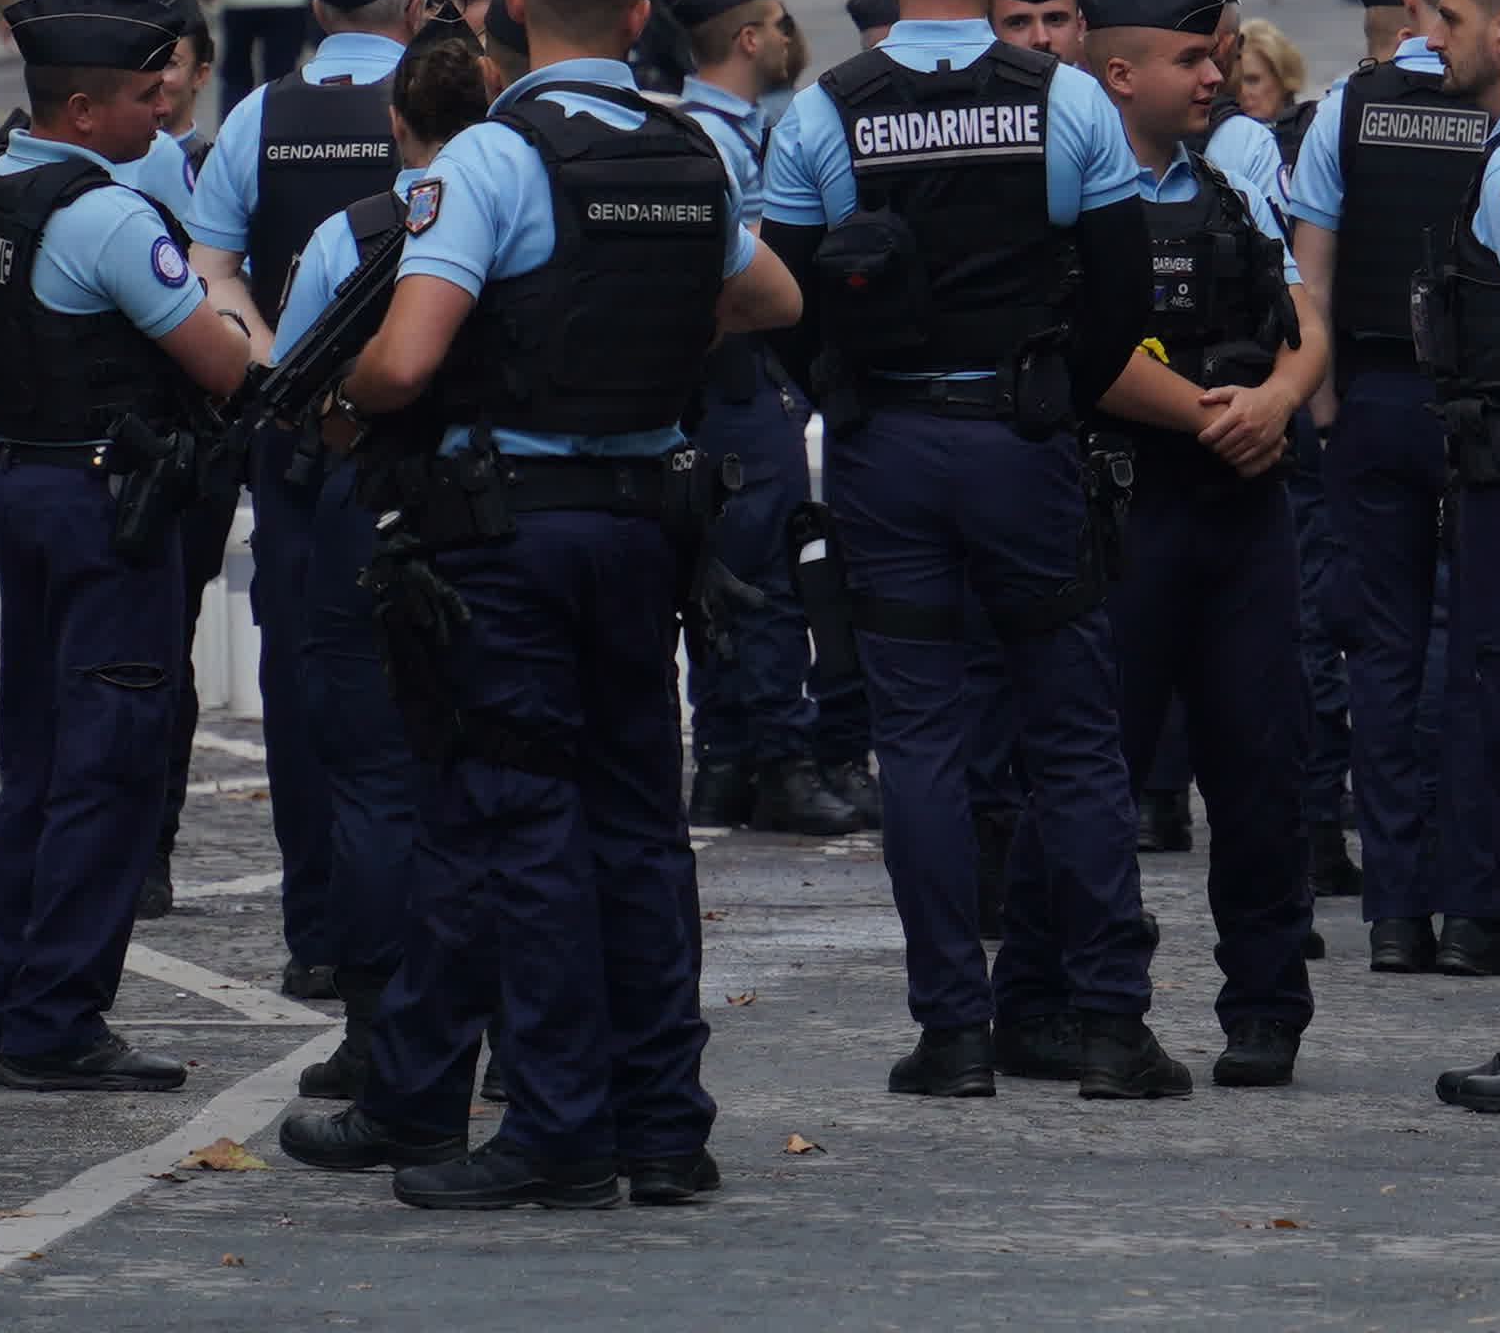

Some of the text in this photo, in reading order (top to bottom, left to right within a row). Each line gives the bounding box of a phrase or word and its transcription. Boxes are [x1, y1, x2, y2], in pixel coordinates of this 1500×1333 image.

[854, 104, 1040, 156] GENDARMERIE
[1365, 111, 1485, 145] GENDARMERIE
[266, 142, 390, 160] GENDARMERIE
[587, 202, 713, 223] GENDARMERIE
